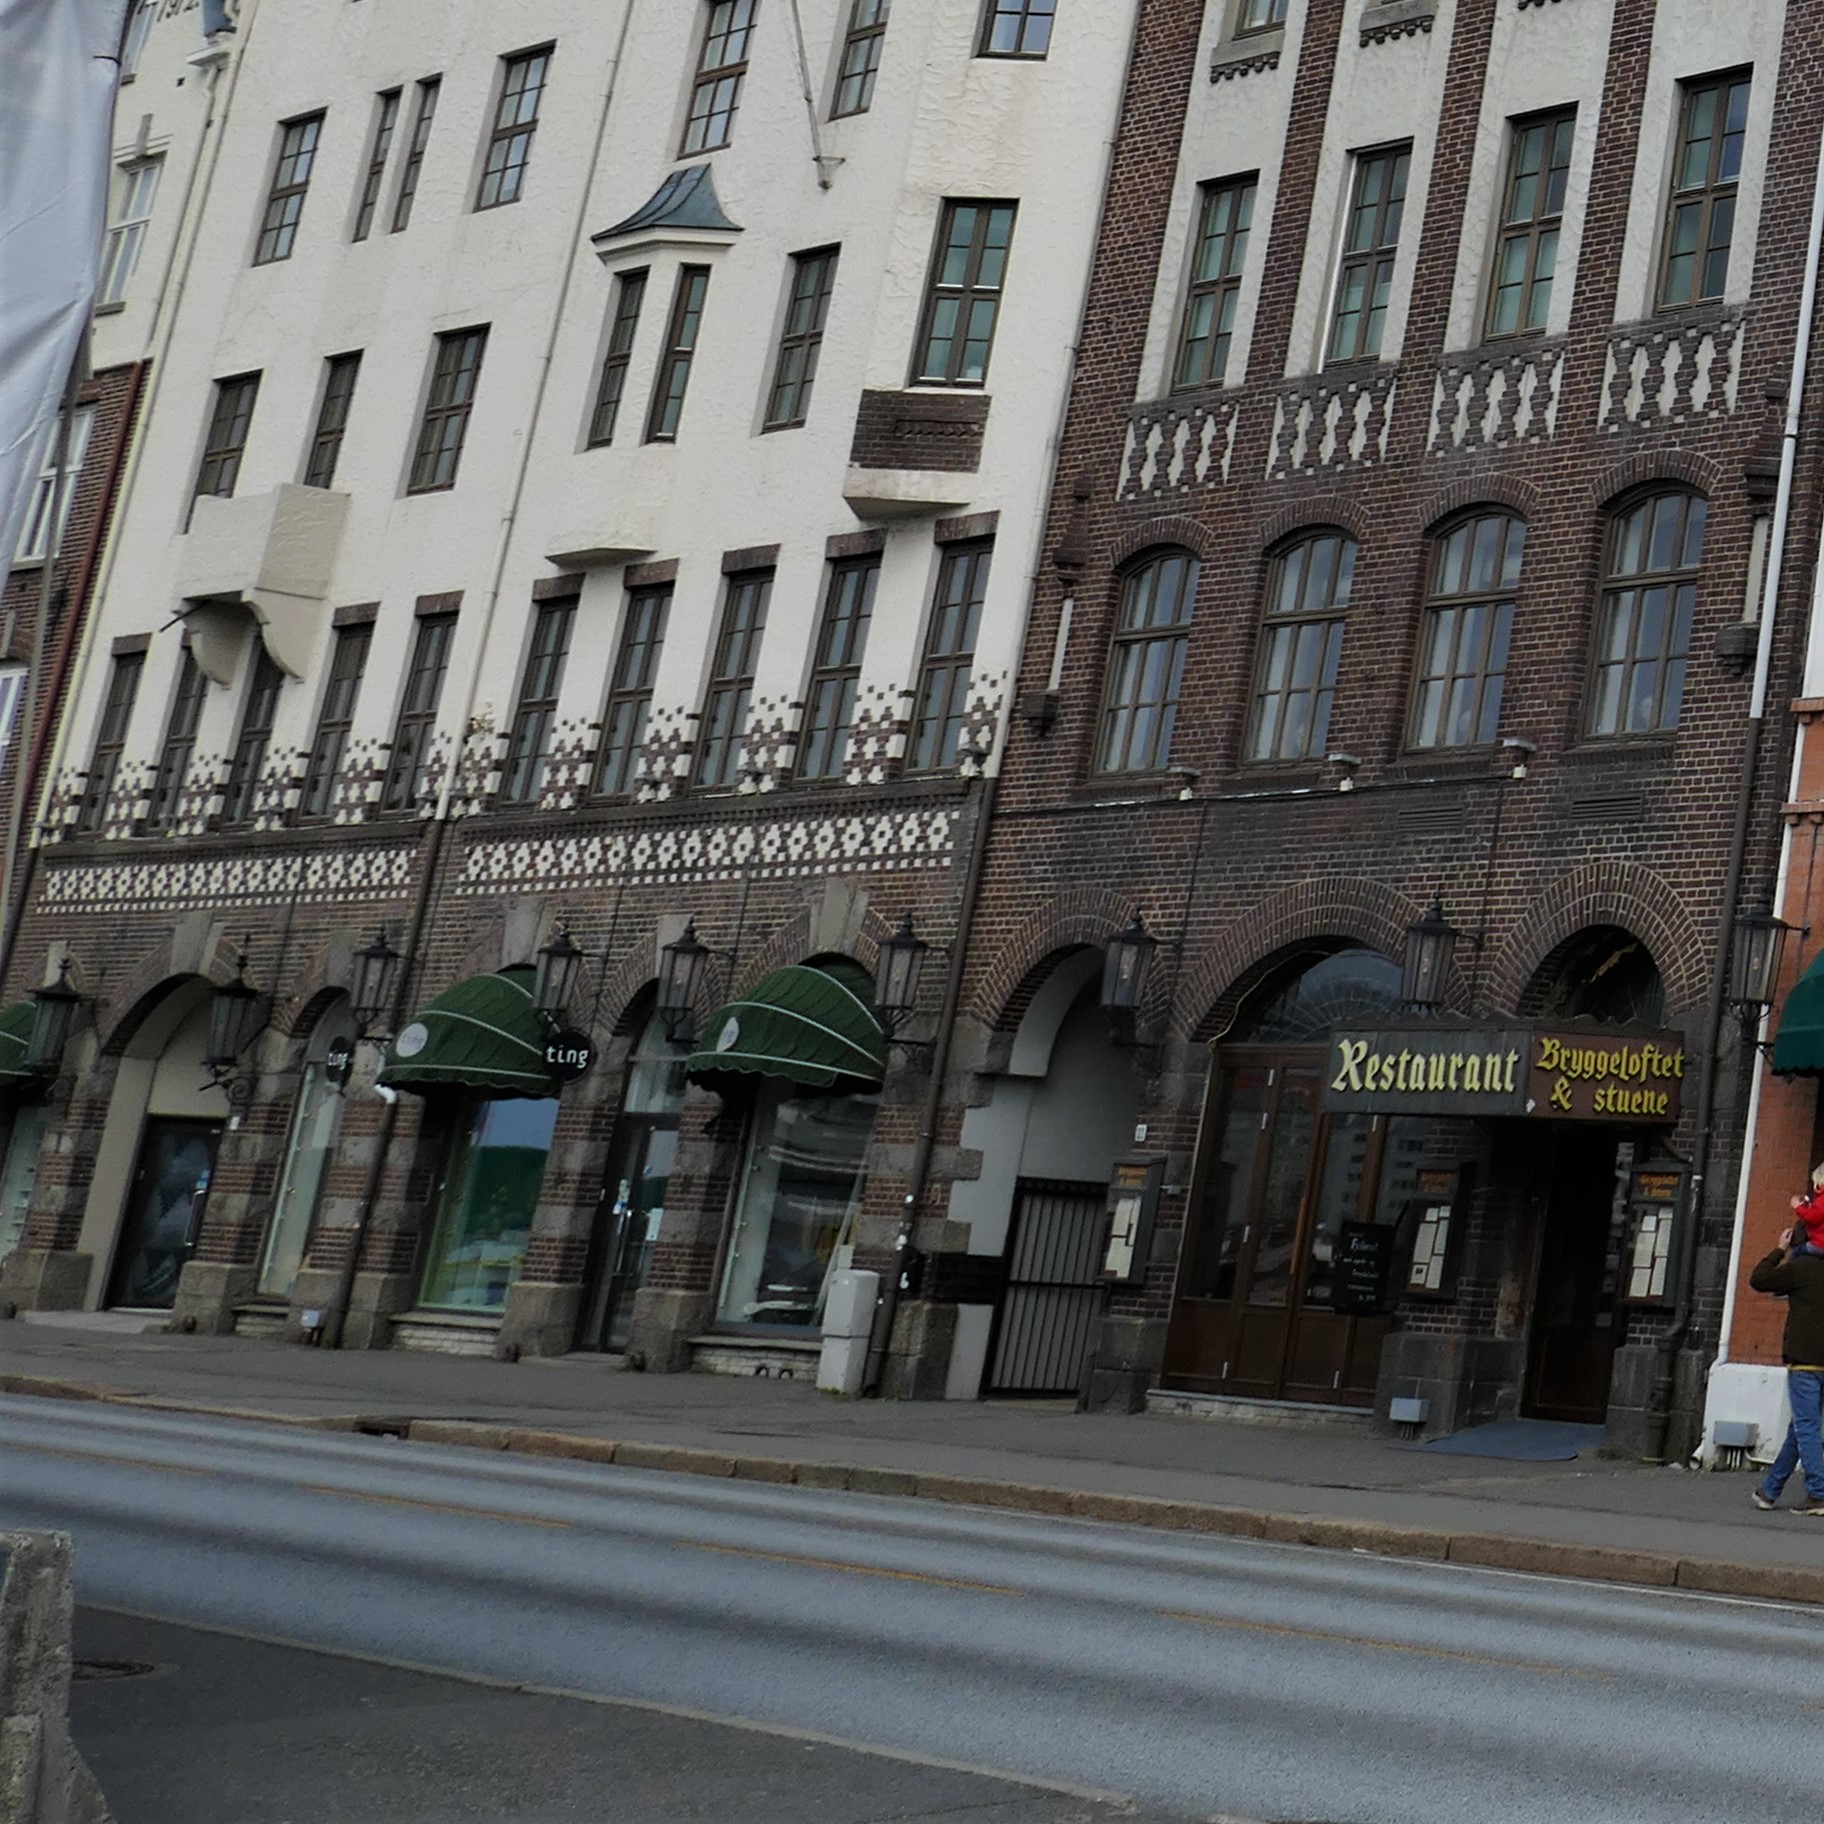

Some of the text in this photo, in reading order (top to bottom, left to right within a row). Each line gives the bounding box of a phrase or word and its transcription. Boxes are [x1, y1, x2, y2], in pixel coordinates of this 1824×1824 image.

[328, 1051, 348, 1070] ting
[545, 1044, 590, 1069] ting
[1331, 1038, 1519, 1093] Restaurant
[1536, 1037, 1685, 1084] Bryggeloftet
[1550, 1076, 1669, 1115] & stuene
